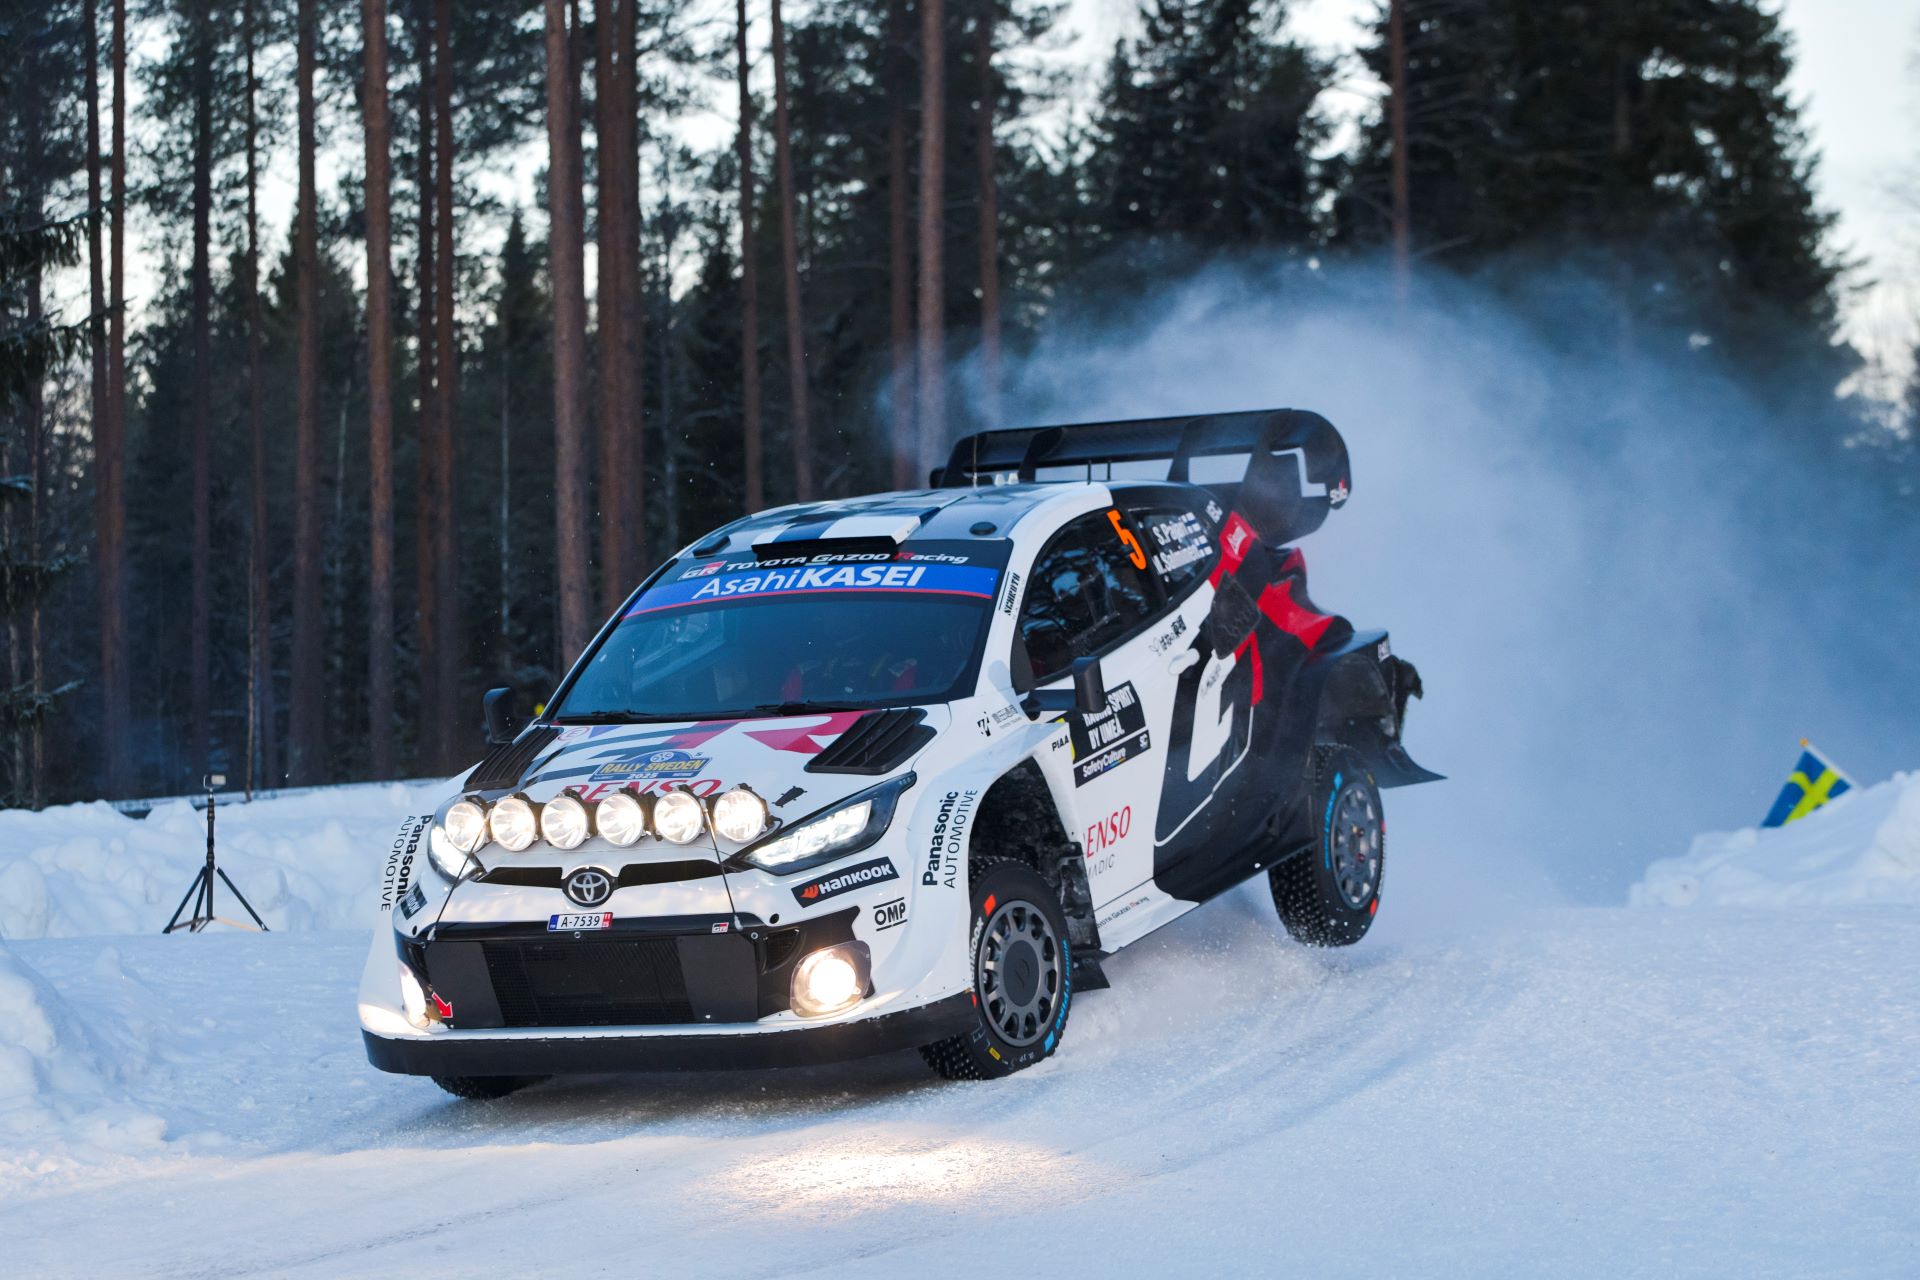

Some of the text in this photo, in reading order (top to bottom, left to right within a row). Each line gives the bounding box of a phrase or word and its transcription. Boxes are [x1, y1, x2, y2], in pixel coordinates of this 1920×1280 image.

[1106, 509, 1147, 570] 5
[726, 556, 808, 572] TOYOTA
[893, 552, 970, 564] Racing
[1107, 684, 1136, 713] SPIRIT
[1051, 735, 1070, 752] PIAA
[1088, 727, 1101, 750] BY
[601, 758, 706, 774] RALLY SWEDEN
[922, 790, 960, 886] Panasonic
[943, 789, 979, 889] AUTOMOTIVE
[1086, 805, 1131, 859] ENSO
[381, 815, 416, 912] AUTOMOTIVE
[560, 915, 601, 928] A-7539
[874, 902, 907, 927] OMP
